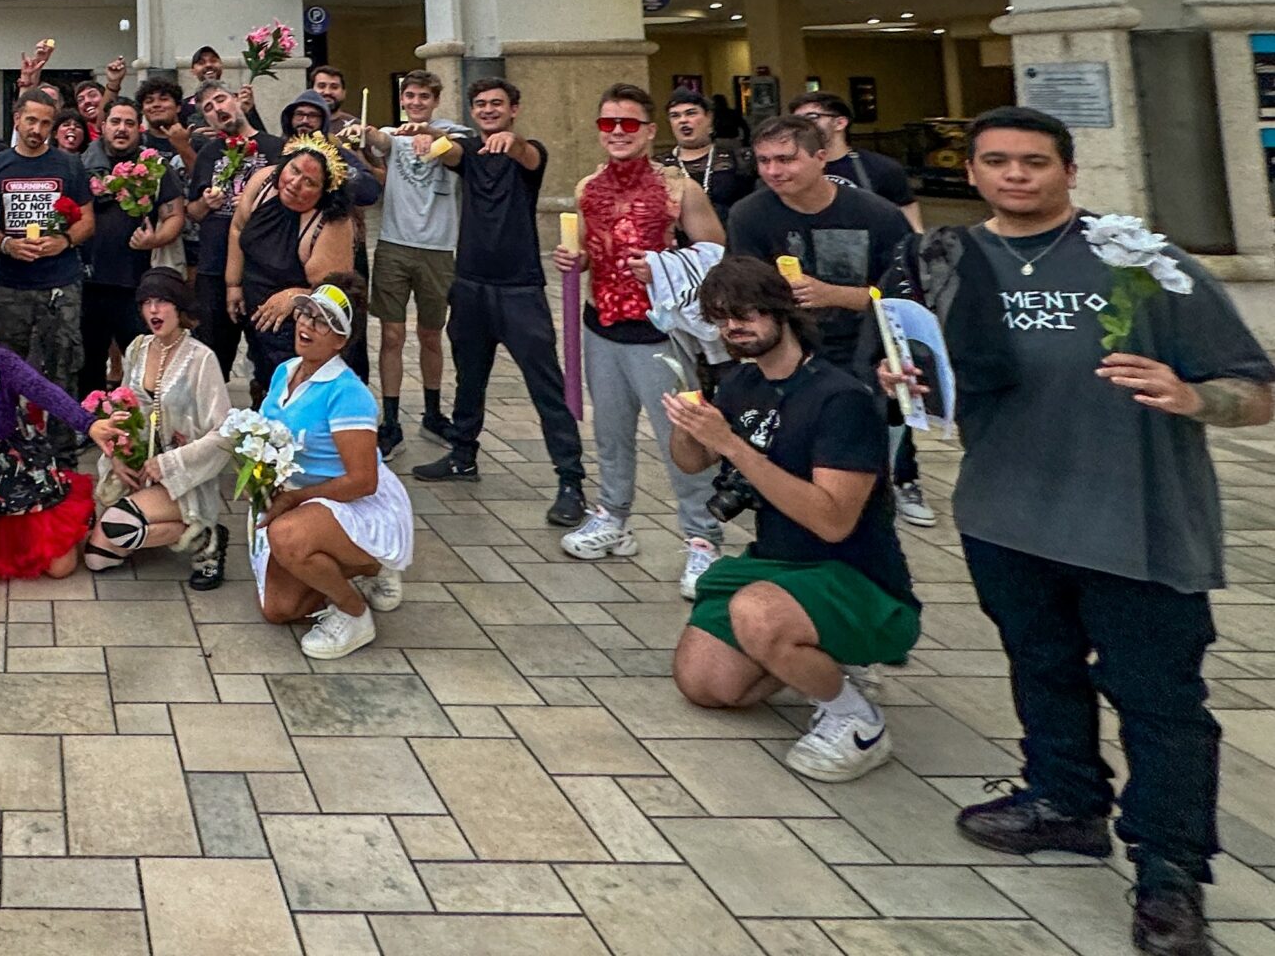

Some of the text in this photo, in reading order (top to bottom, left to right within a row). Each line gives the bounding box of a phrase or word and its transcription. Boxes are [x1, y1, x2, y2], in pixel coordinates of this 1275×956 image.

[11, 194, 52, 202] PLEASE
[11, 203, 52, 211] DO NOT
[7, 211, 56, 220] FEED THE
[998, 291, 1108, 311] MENTO
